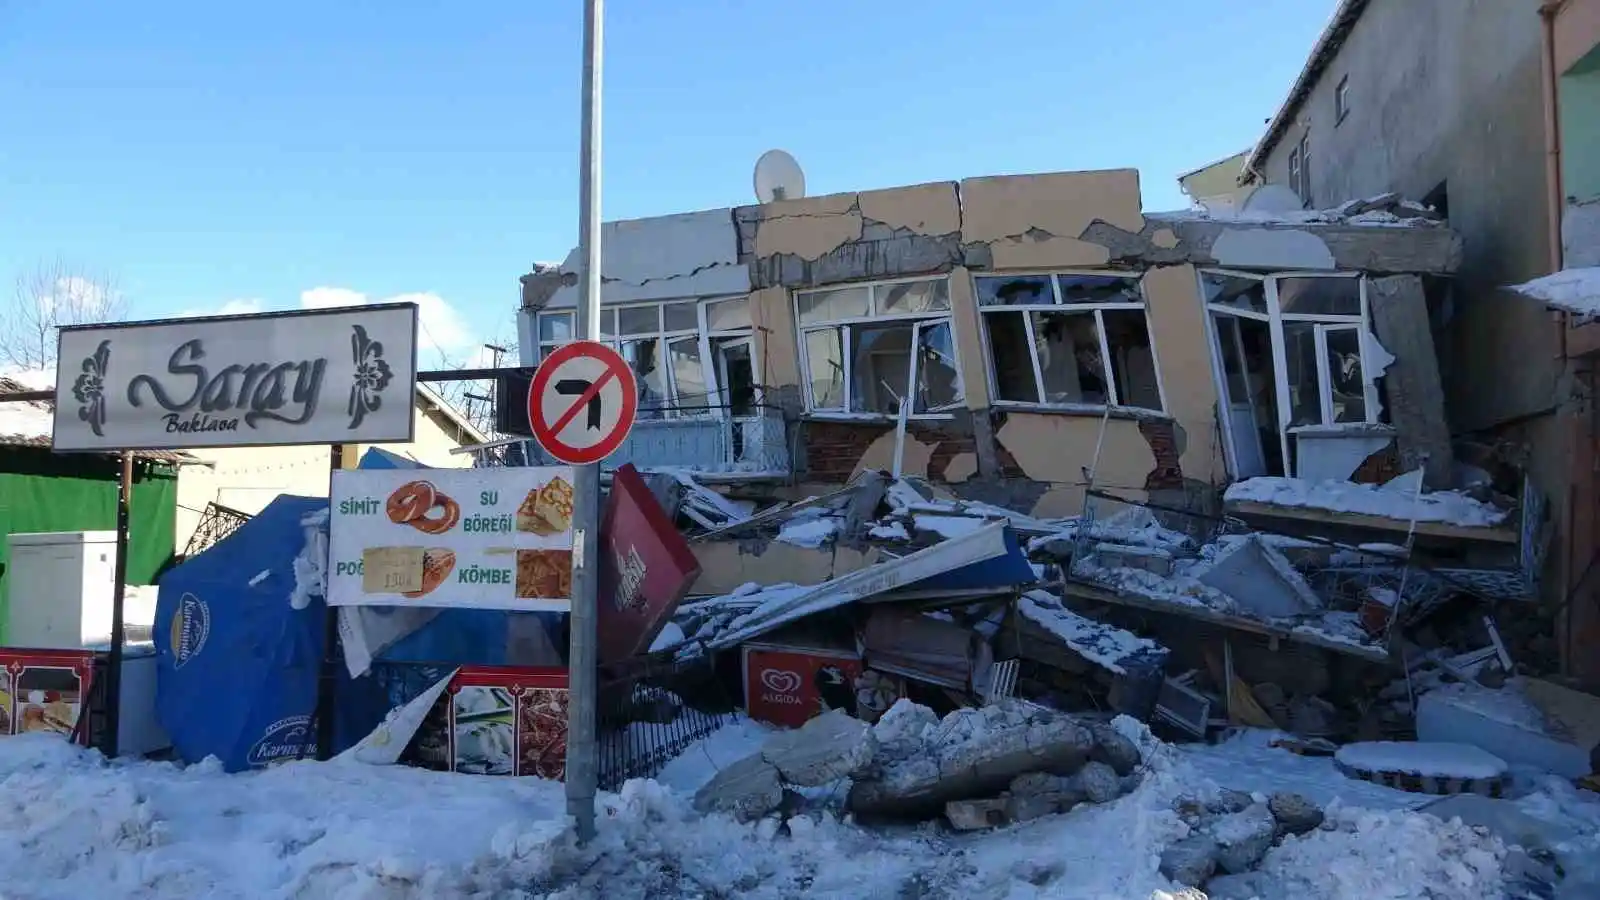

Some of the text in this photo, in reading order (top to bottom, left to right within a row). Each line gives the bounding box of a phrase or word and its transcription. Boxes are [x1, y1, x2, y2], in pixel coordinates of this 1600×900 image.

[127, 338, 328, 429] Saray
[161, 412, 240, 434] Baklava
[339, 496, 381, 515] SİMİT
[480, 491, 498, 506] SU
[463, 513, 512, 533] BÖREĞİ
[459, 565, 512, 585] KÖMBE
